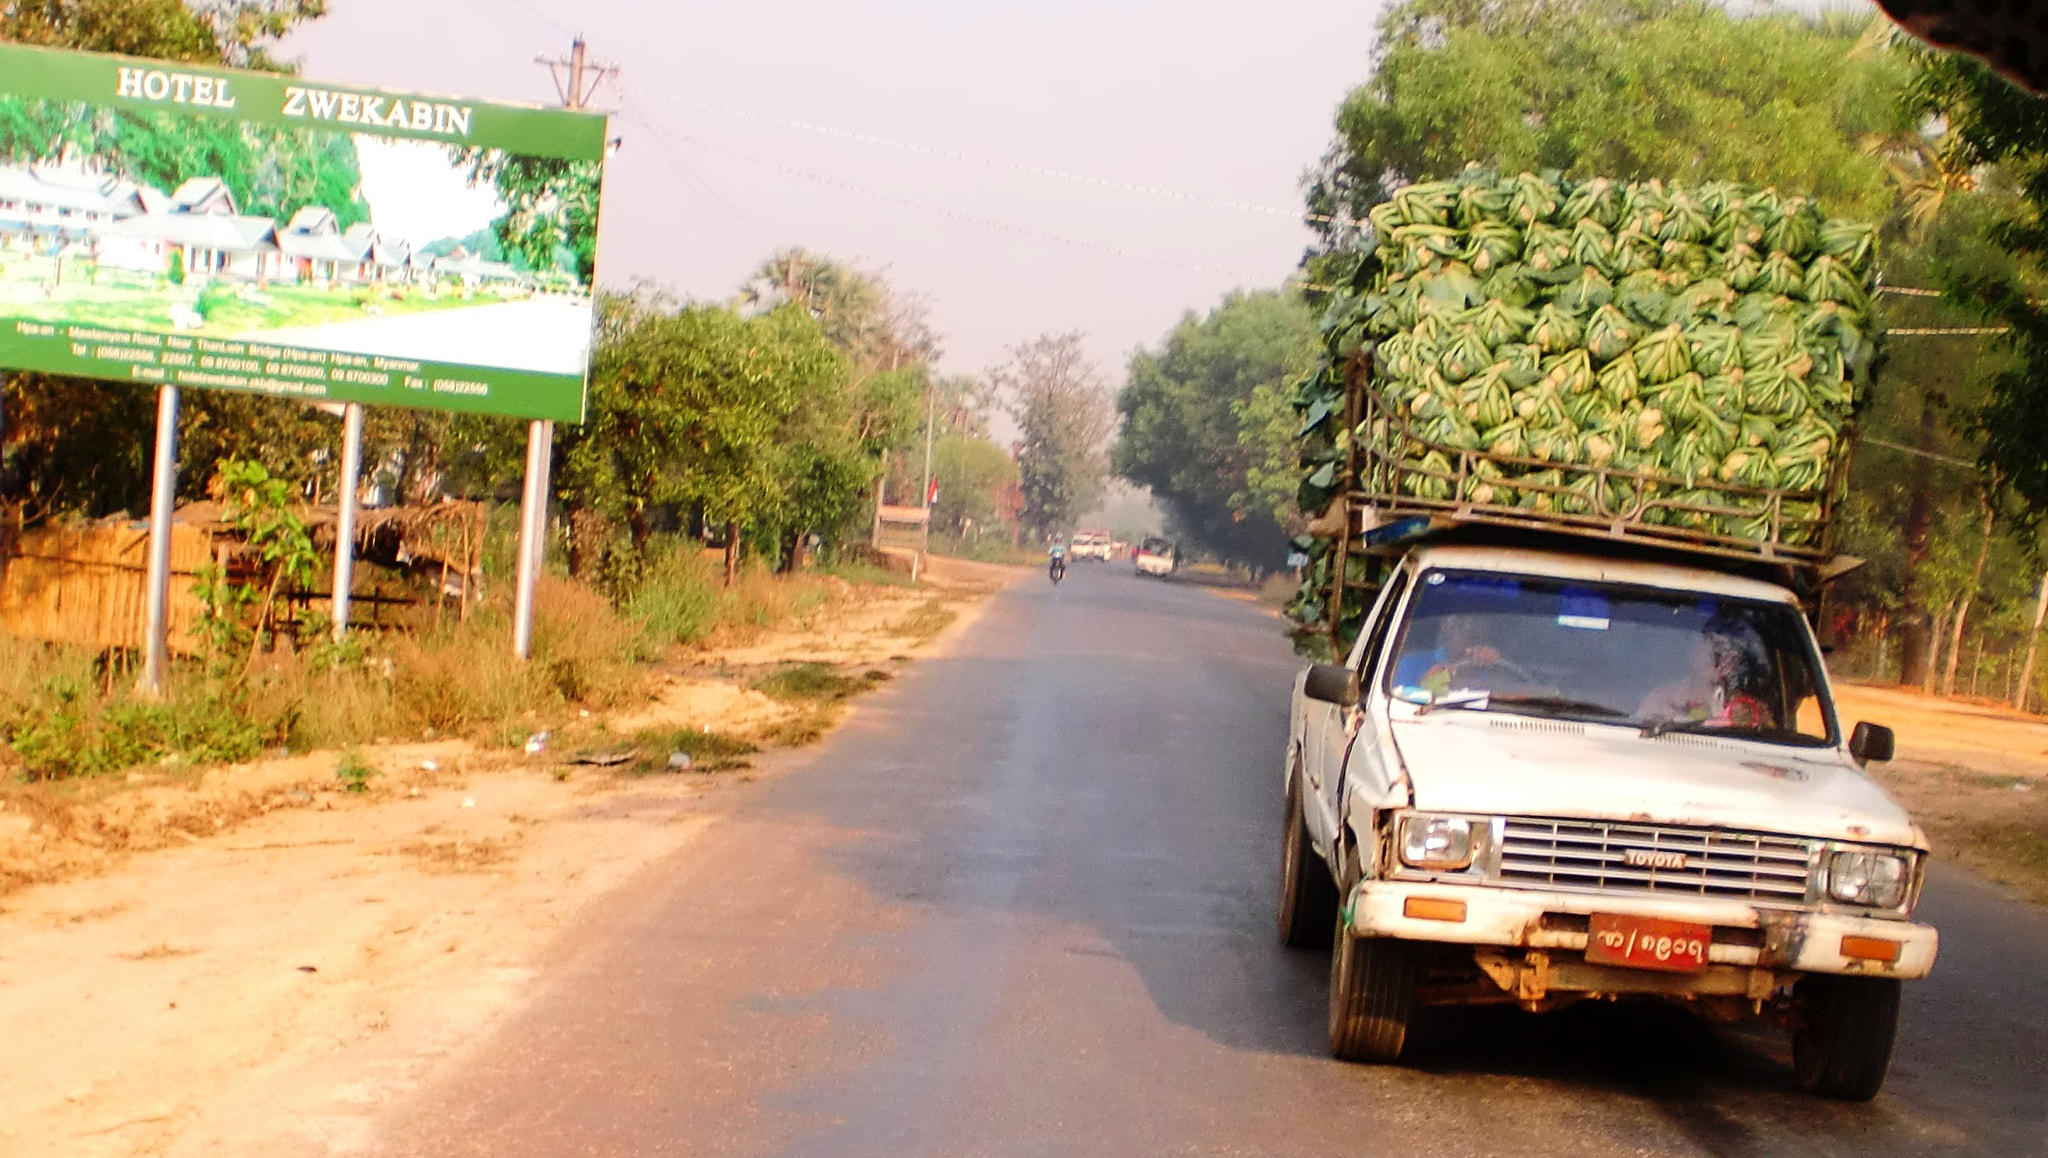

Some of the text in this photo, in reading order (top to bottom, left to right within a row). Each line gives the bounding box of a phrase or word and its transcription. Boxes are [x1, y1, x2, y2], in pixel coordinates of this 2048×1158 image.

[117, 67, 473, 137] HOTEL ZWEKABIN
[248, 344, 281, 360] Bridge
[404, 375, 423, 389] Fax
[1629, 852, 1684, 868] TOYOTA
